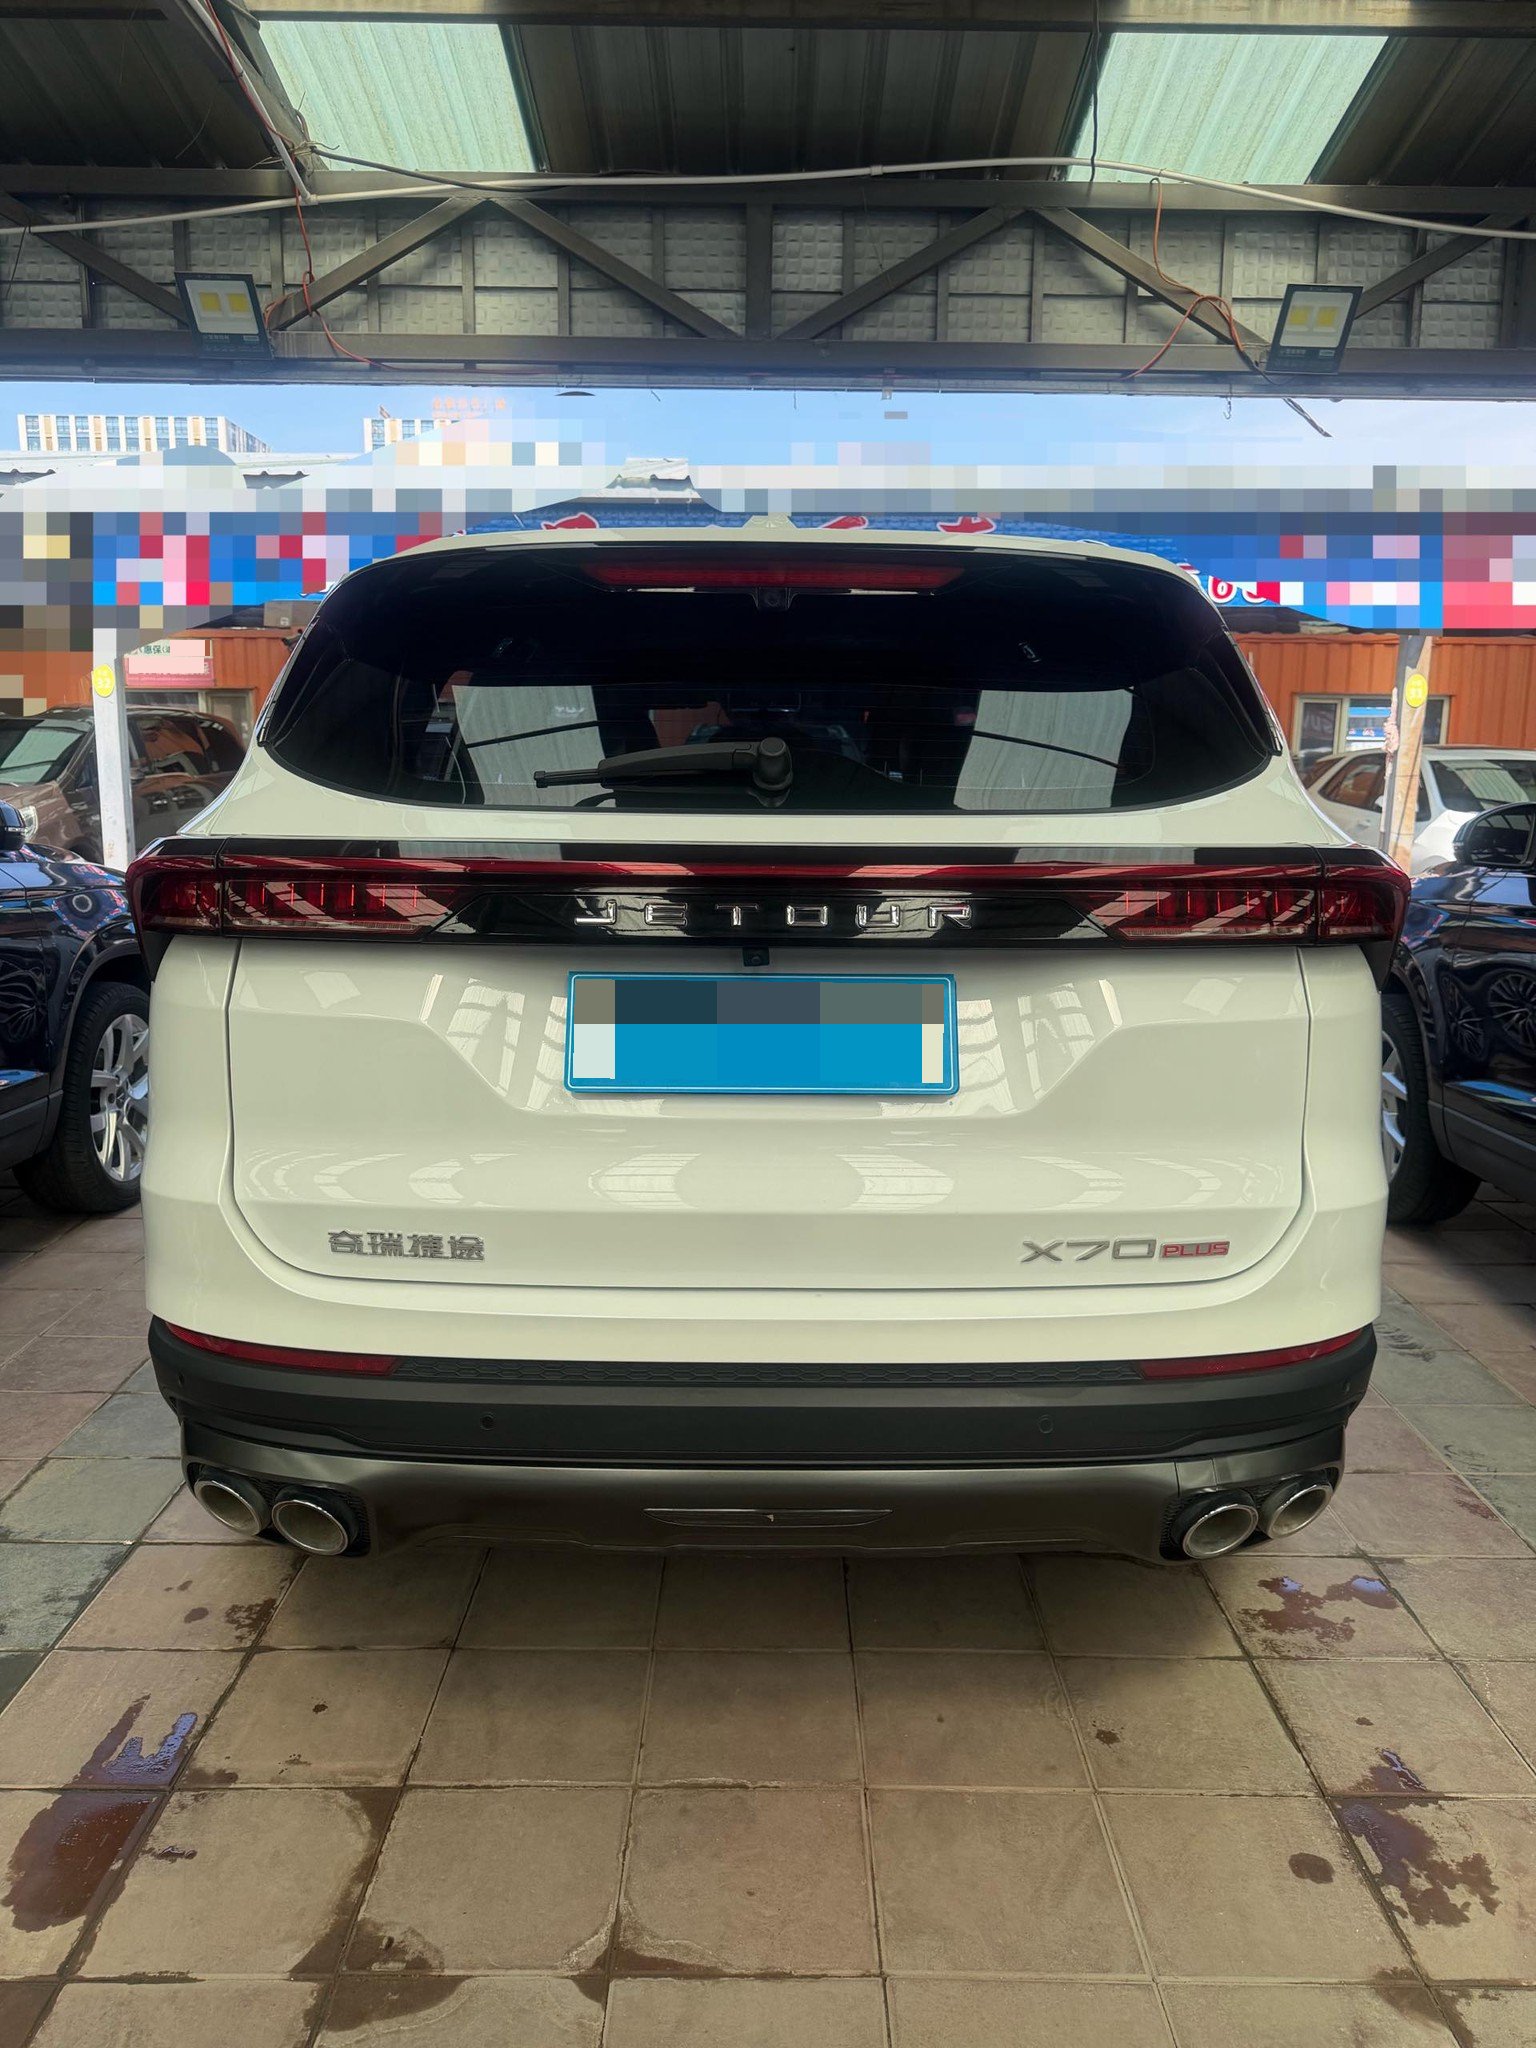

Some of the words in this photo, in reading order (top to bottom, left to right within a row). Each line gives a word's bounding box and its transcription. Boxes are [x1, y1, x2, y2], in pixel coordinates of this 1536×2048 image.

[573, 899, 973, 930] JETOUR
[328, 1229, 484, 1260] 奇瑞捷途
[1021, 1238, 1157, 1263] X70
[1161, 1240, 1230, 1259] PLUS
